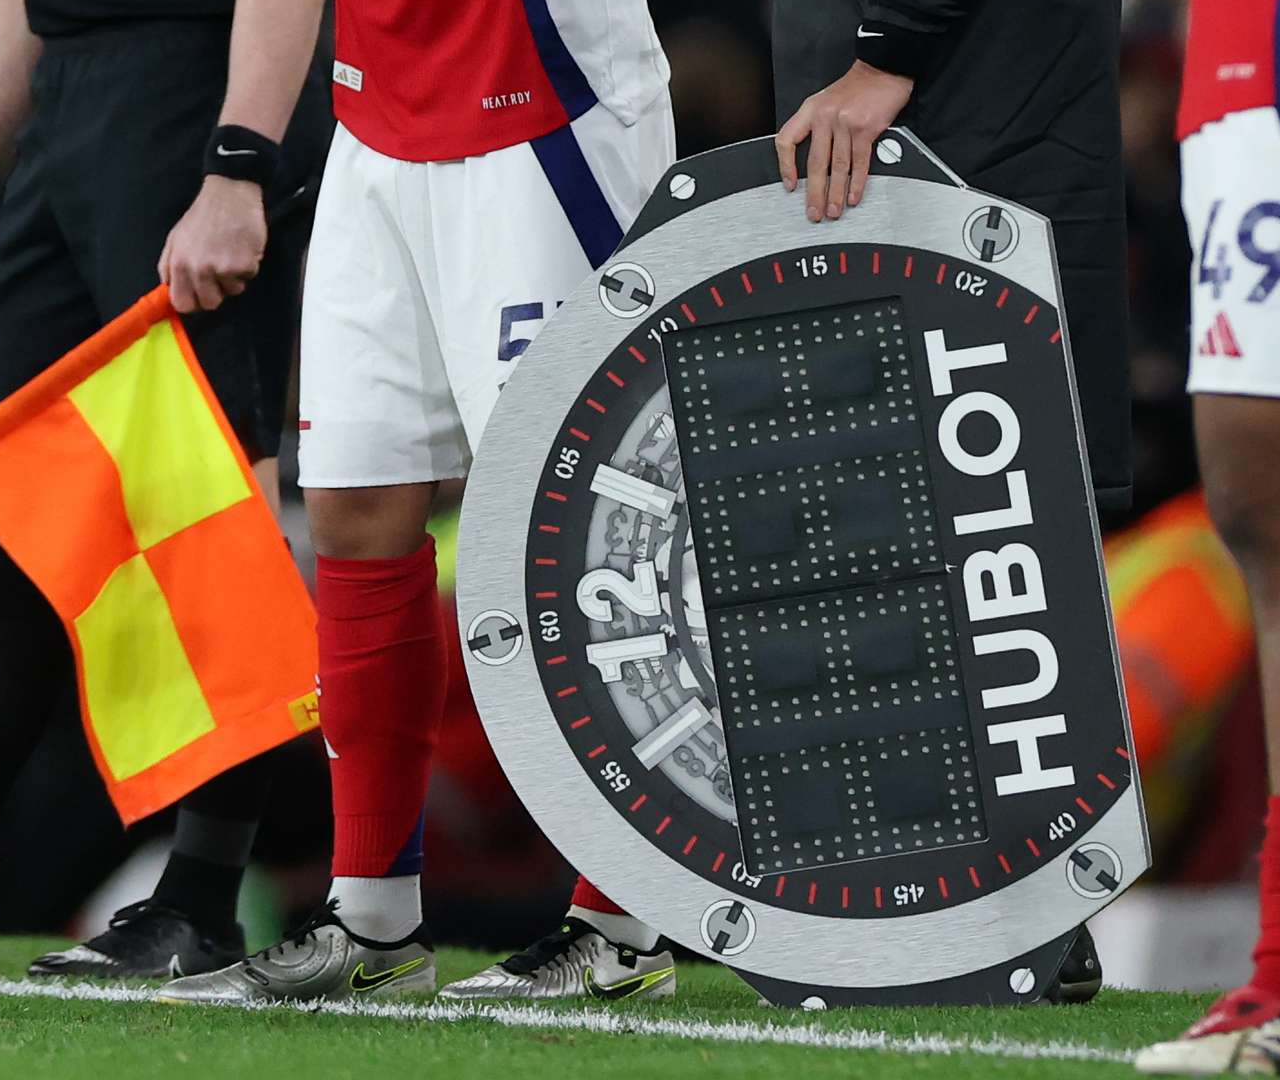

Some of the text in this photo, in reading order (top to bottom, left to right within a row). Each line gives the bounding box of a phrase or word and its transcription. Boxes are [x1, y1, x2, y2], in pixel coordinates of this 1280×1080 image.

[481, 90, 532, 110] HEAT.RDY
[795, 254, 829, 278] 15
[954, 270, 988, 297] 20
[554, 446, 581, 480] 05
[924, 329, 1076, 797] HUBLOT
[539, 610, 561, 642] 60
[576, 560, 669, 684] 12
[600, 761, 631, 793] 55
[1048, 811, 1077, 842] 40
[893, 884, 925, 906] 45
